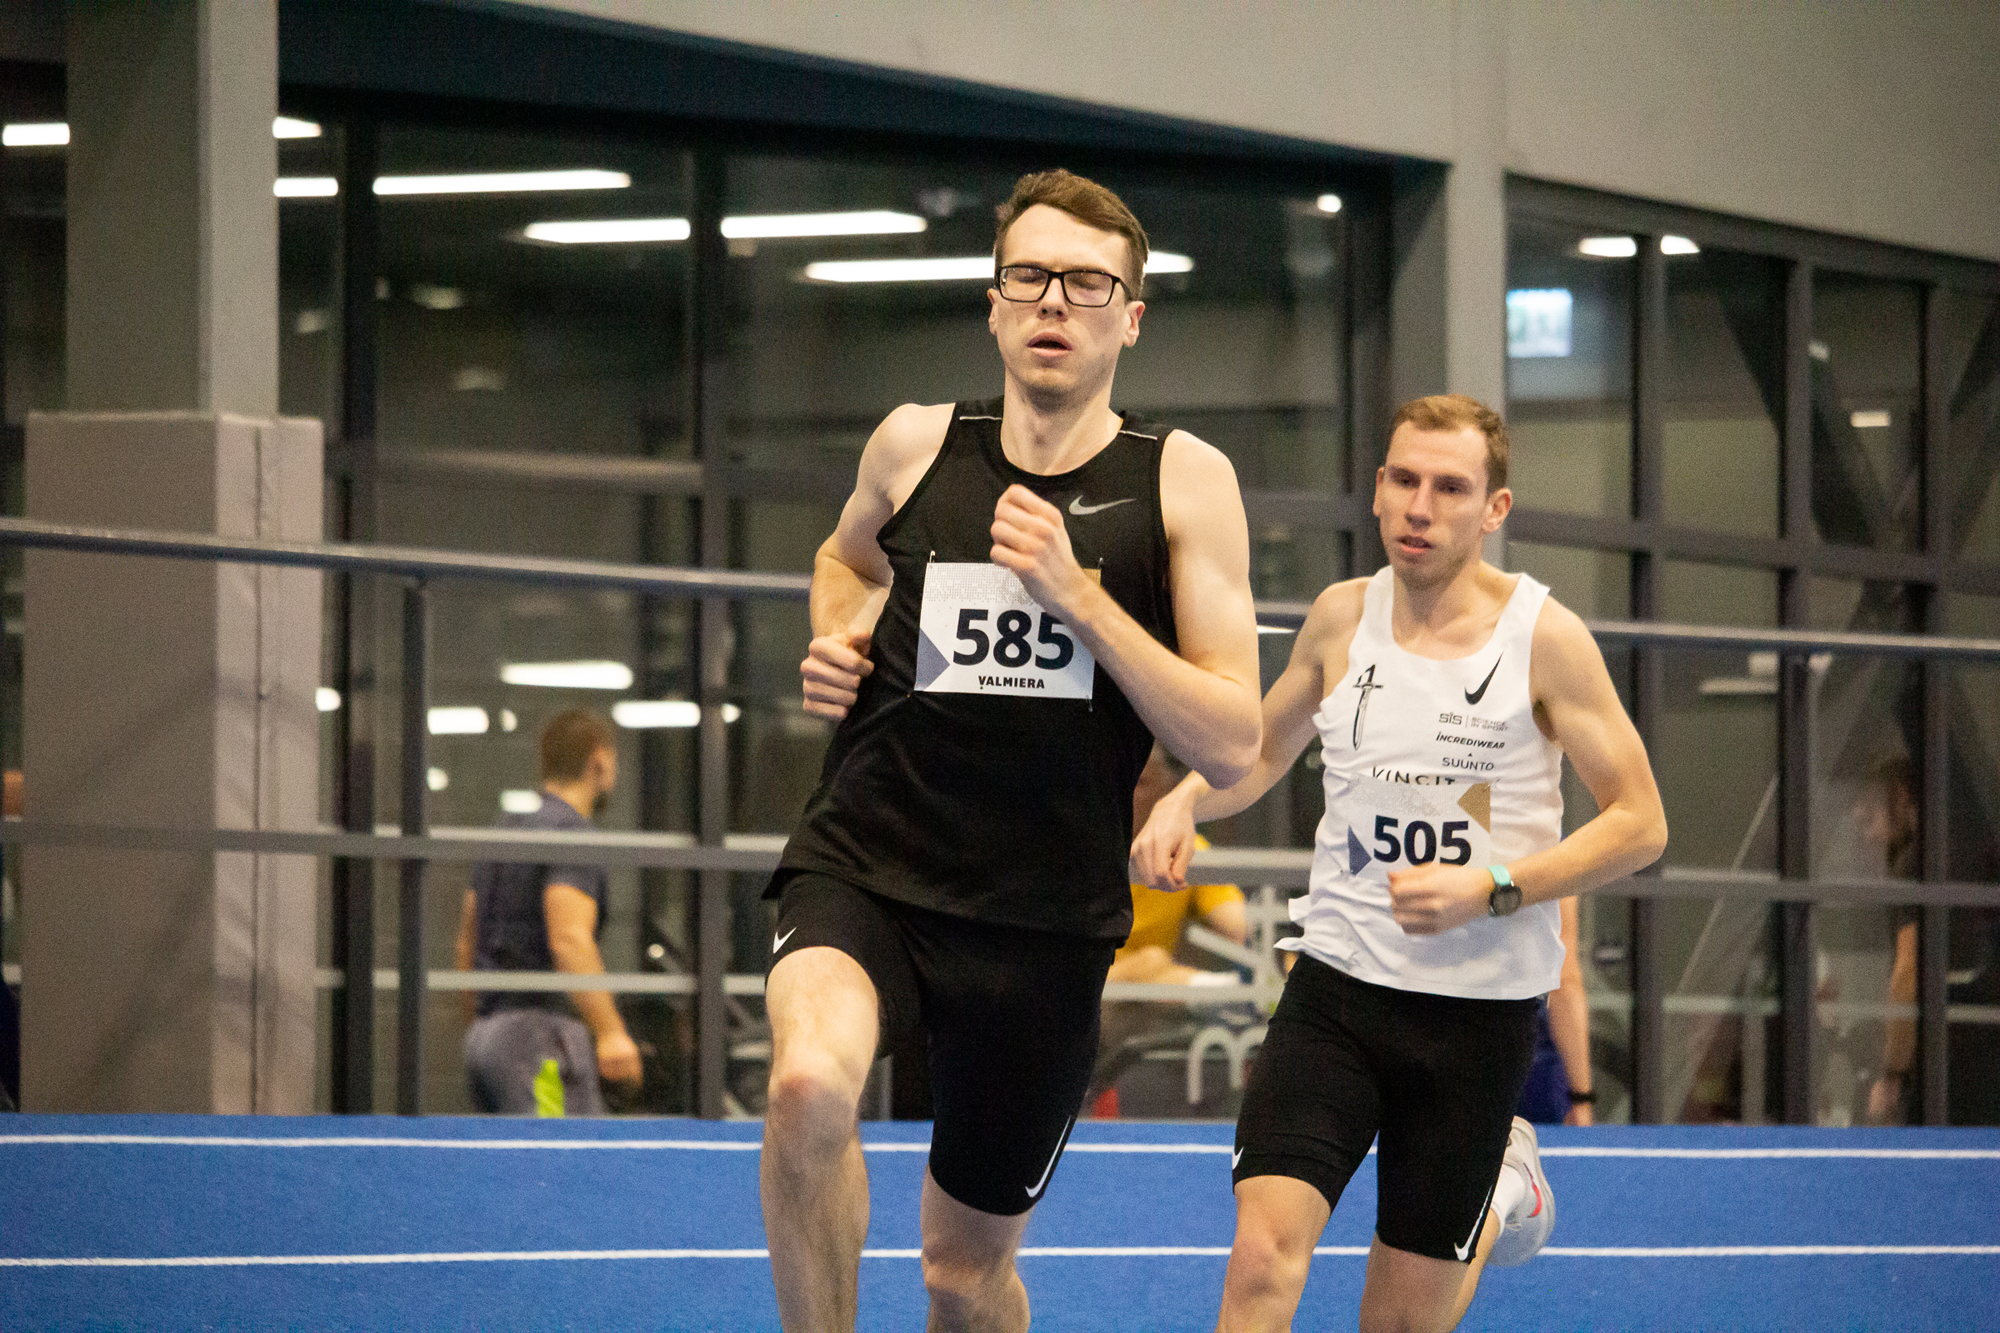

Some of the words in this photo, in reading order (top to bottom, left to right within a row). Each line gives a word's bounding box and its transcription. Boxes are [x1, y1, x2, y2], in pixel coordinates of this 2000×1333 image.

[953, 608, 1074, 670] 585
[978, 675, 1045, 689] VALMIERA
[1442, 757, 1494, 771] SUUNTO
[1373, 814, 1472, 866] 505
